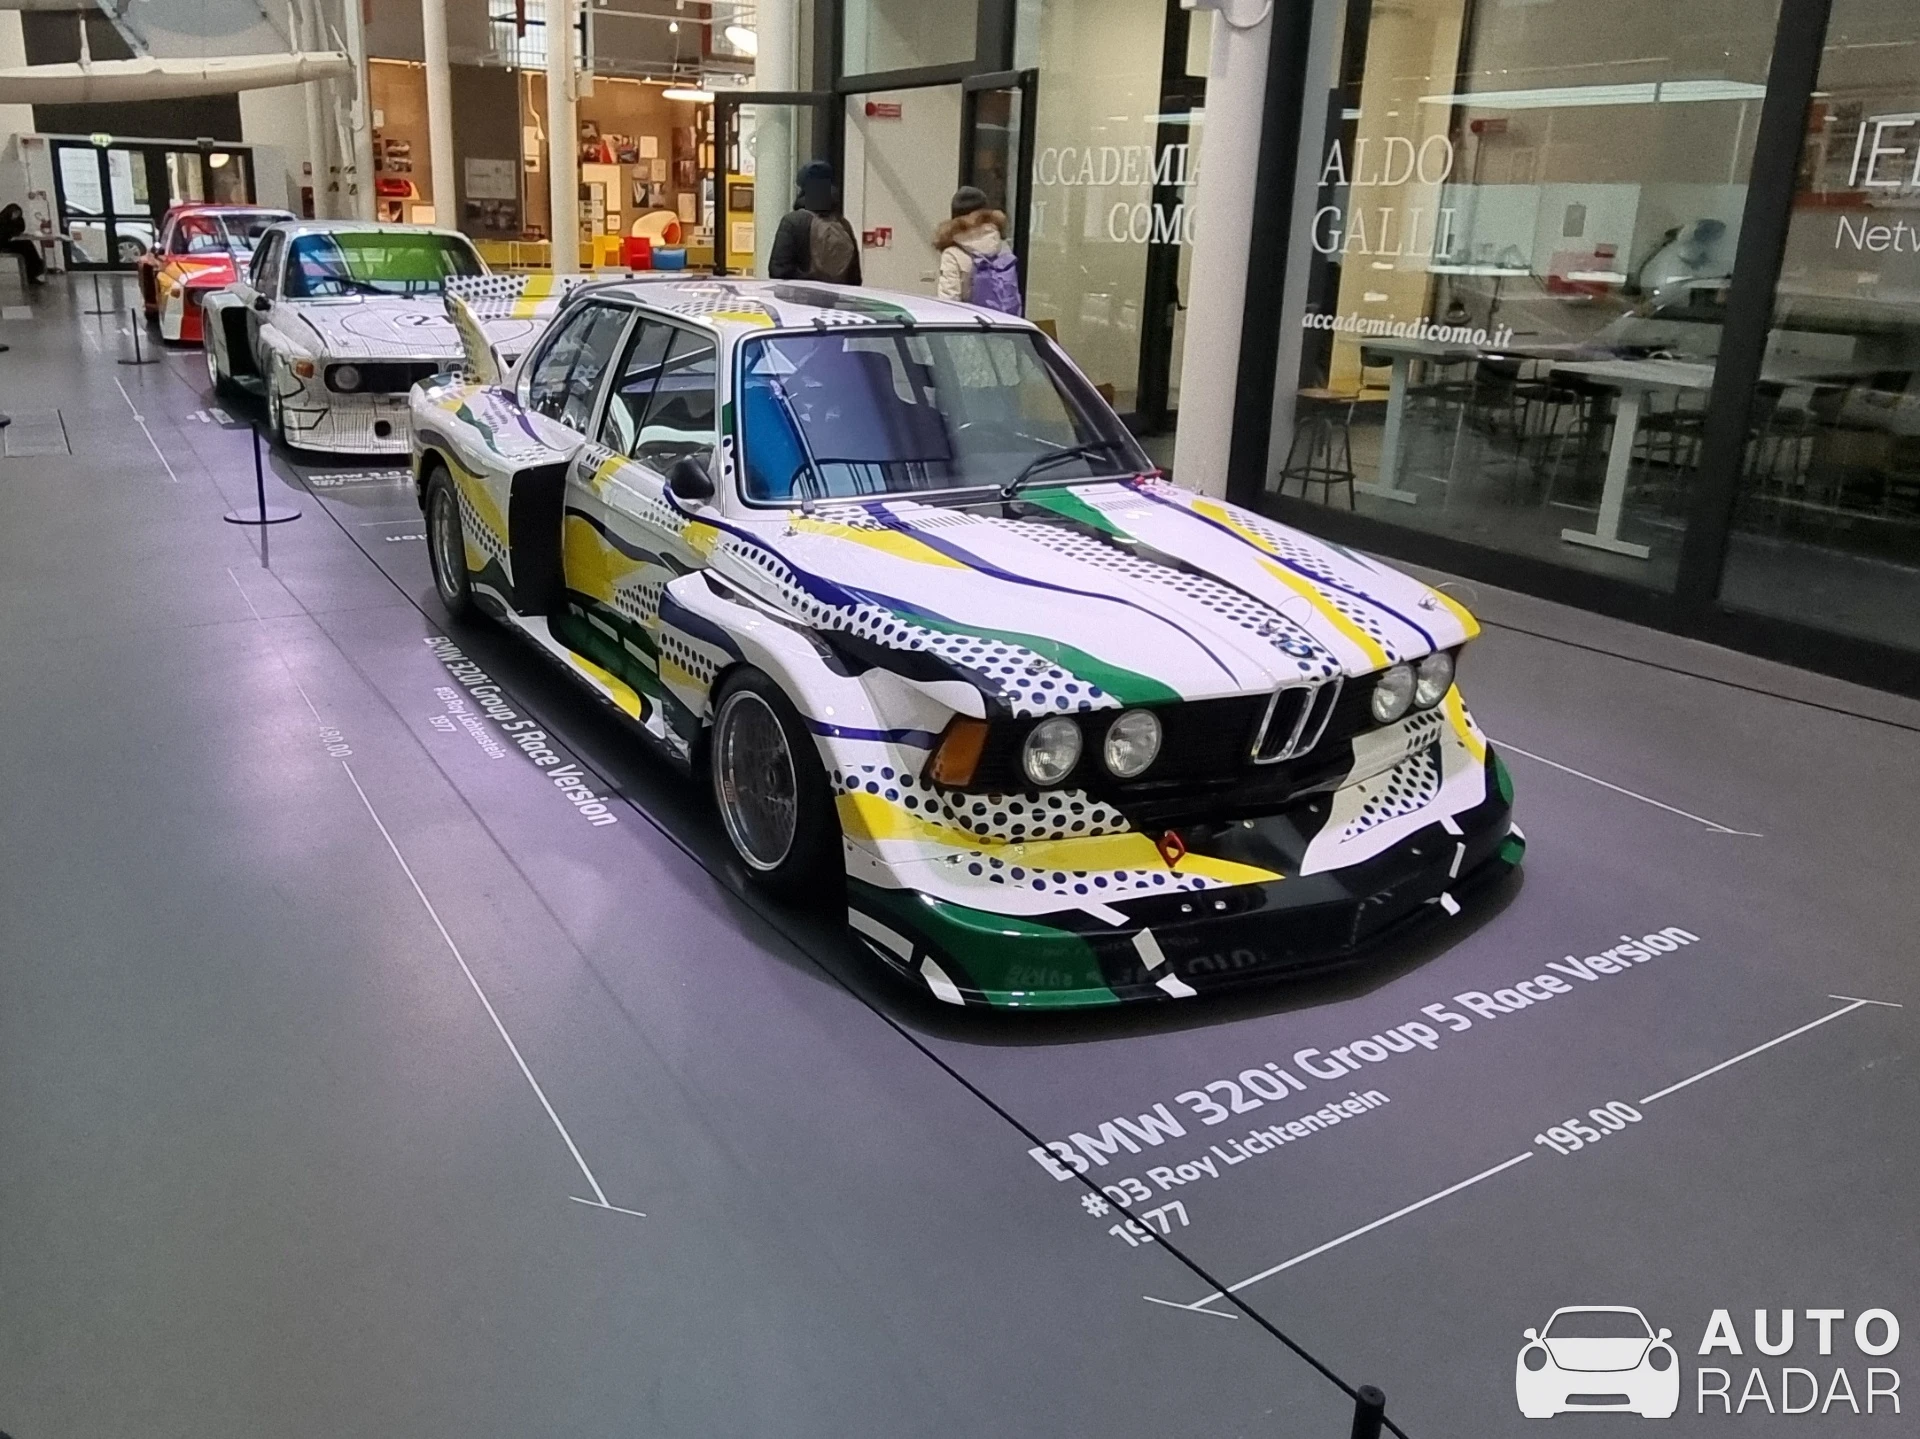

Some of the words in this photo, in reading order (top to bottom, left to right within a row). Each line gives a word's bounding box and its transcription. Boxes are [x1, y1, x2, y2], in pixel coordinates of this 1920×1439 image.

[1032, 143, 1201, 186] CCADEMI
[1317, 134, 1454, 187] ALDO
[1848, 120, 1920, 186] IE
[1311, 206, 1456, 258] GALLI
[1835, 215, 1920, 252] Net
[1301, 311, 1515, 348] accademiadicomo.it
[423, 636, 468, 662] BMW
[446, 661, 492, 686] 320i
[429, 715, 457, 732] 1977
[470, 685, 517, 721] Group
[501, 720, 536, 731] 5
[445, 699, 466, 714] Roy
[456, 712, 507, 760] Lichtenstein
[511, 730, 561, 766] Race
[547, 764, 618, 826] Version
[1028, 1102, 1187, 1182] BMW
[1174, 1062, 1308, 1126] 320i
[1293, 1021, 1440, 1080] Group
[1420, 1003, 1473, 1031] 5
[1453, 974, 1573, 1019] Race
[1545, 926, 1700, 981] Version
[1534, 1100, 1643, 1155] 195.00
[1081, 1177, 1152, 1218] #03
[1146, 1156, 1220, 1191] Roy
[1209, 1090, 1391, 1166] Lichtenstein
[1108, 1200, 1190, 1247] 1977
